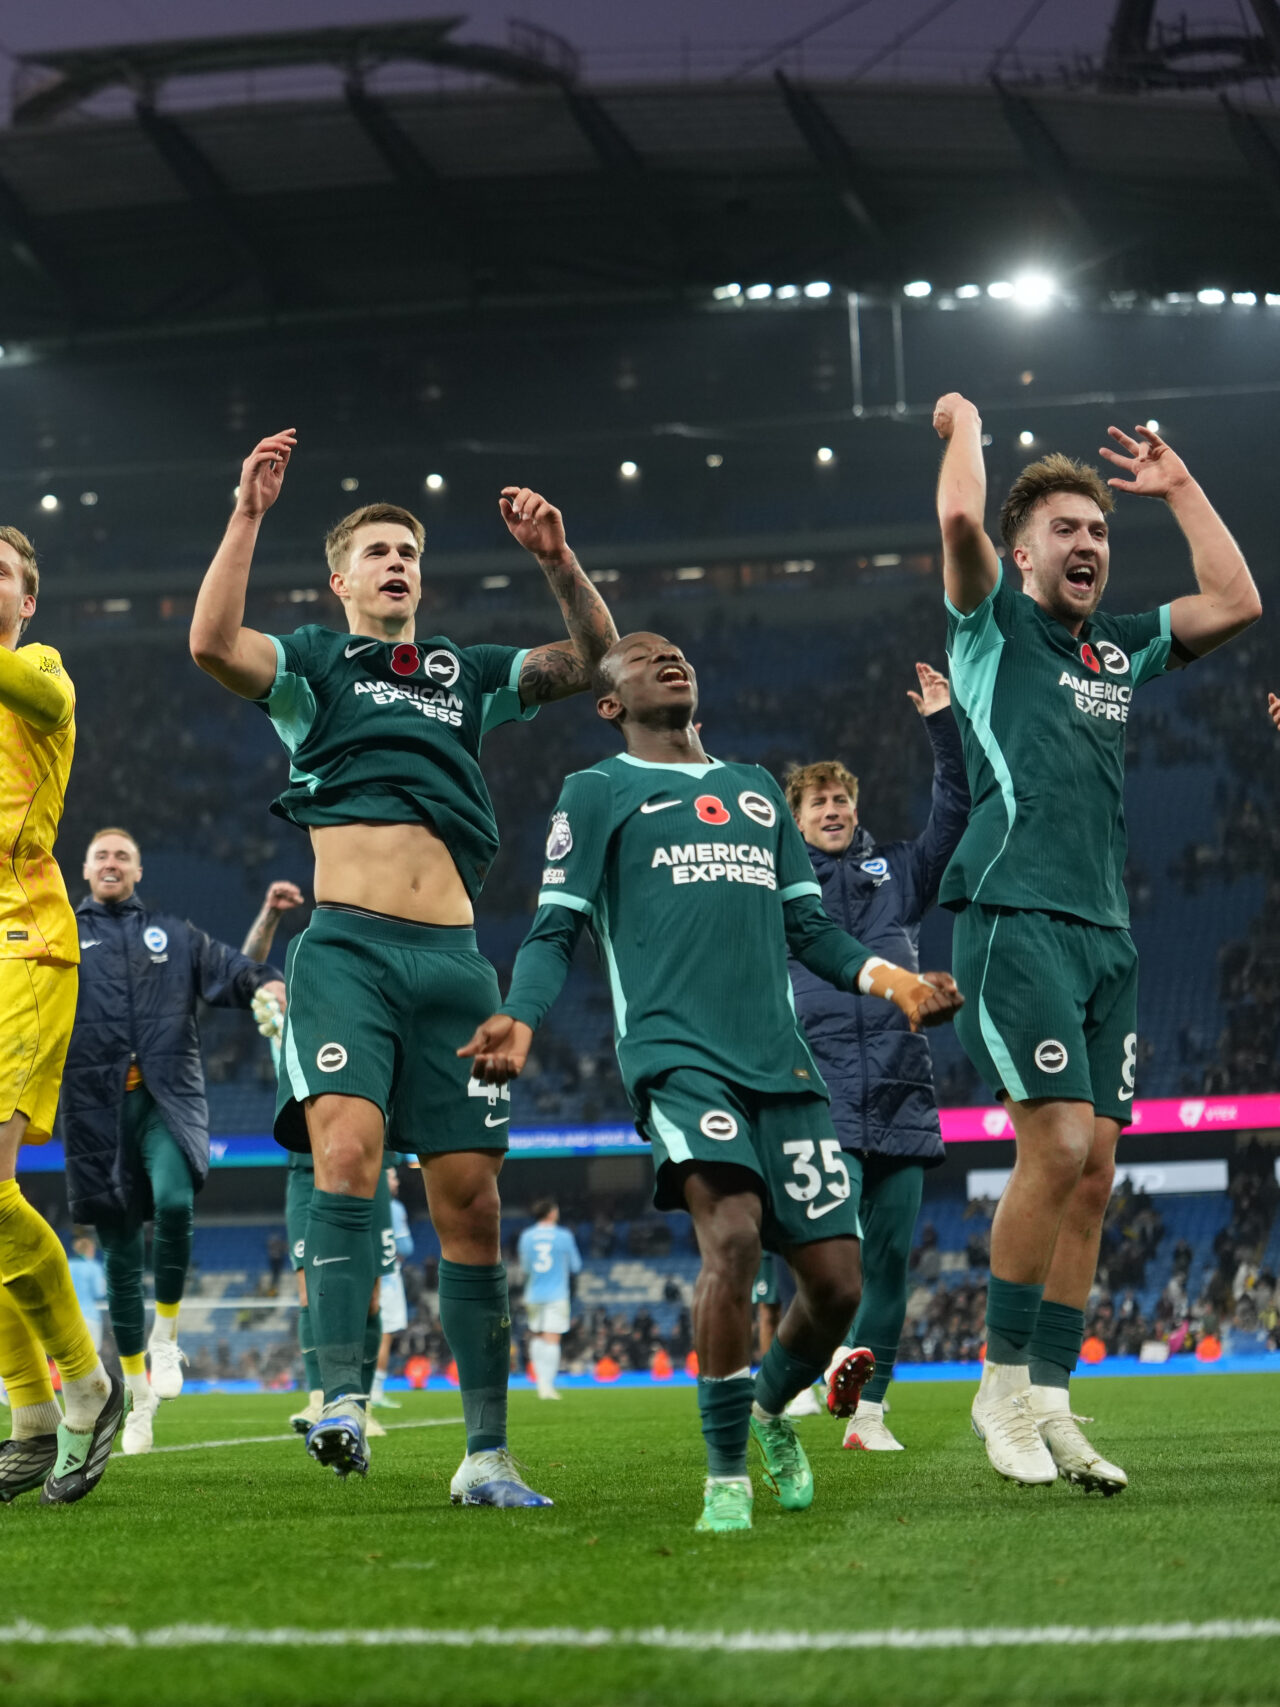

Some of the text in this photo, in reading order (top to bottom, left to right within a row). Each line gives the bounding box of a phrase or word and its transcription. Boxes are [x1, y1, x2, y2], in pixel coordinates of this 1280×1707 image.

[1058, 671, 1133, 703] AMERIC
[372, 690, 463, 727] EXESS
[651, 842, 775, 870] AMERICAN
[672, 862, 777, 891] EXPRESS
[467, 1076, 511, 1107] 4
[782, 1138, 851, 1202] 35
[533, 1242, 554, 1274] 3
